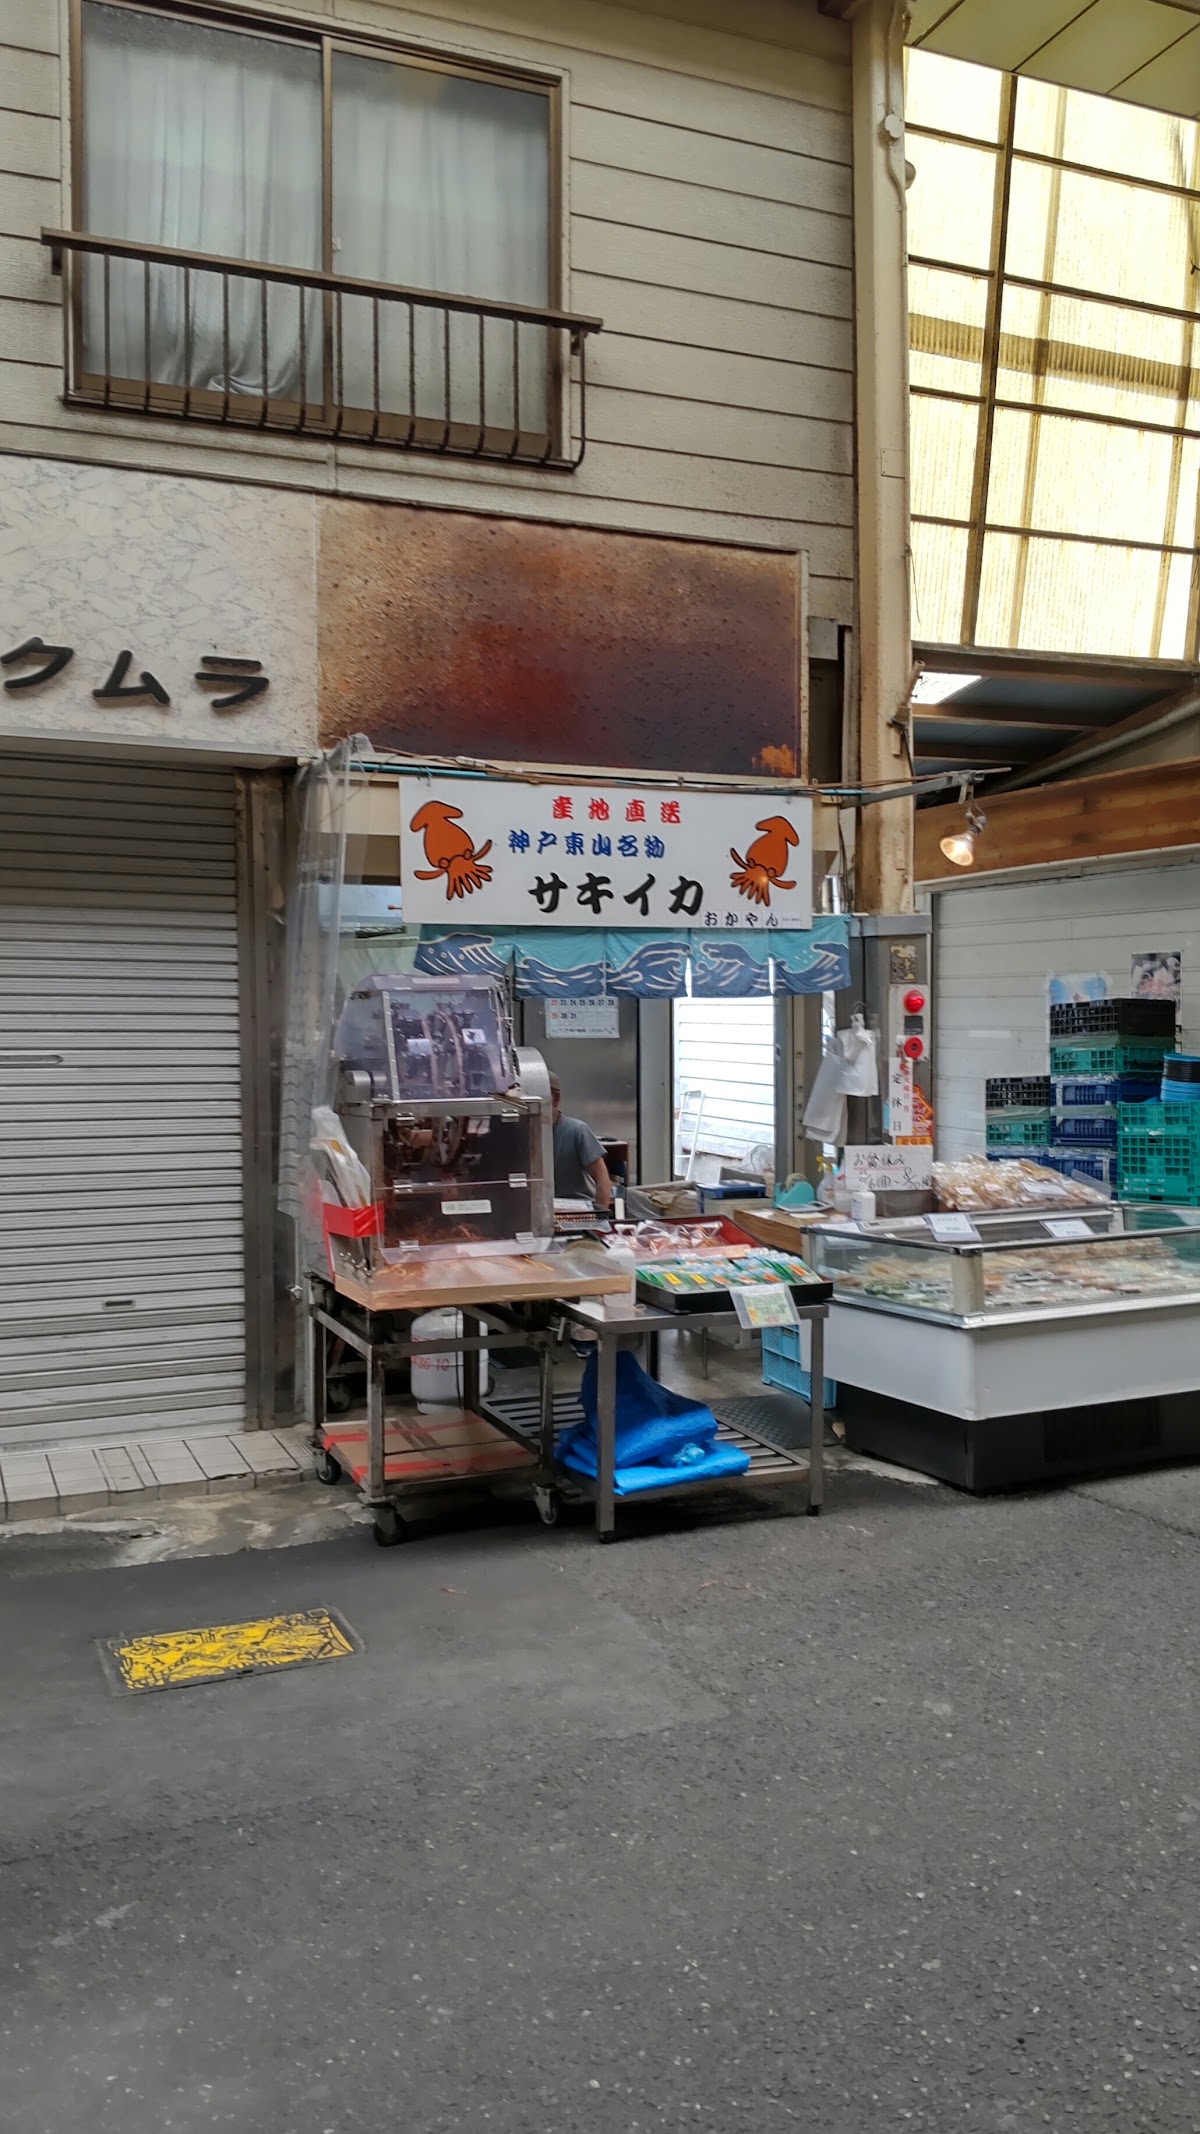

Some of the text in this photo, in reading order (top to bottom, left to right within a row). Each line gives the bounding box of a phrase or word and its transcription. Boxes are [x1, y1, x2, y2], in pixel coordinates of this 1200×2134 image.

[0, 636, 270, 709] クムラ
[552, 795, 682, 824] 産地直送
[508, 829, 666, 859] 神戸東山名物
[528, 872, 704, 917] サキイカ
[704, 910, 779, 927] おかやん
[891, 1073, 902, 1132] 定休日
[853, 1152, 905, 1168] お盆休み
